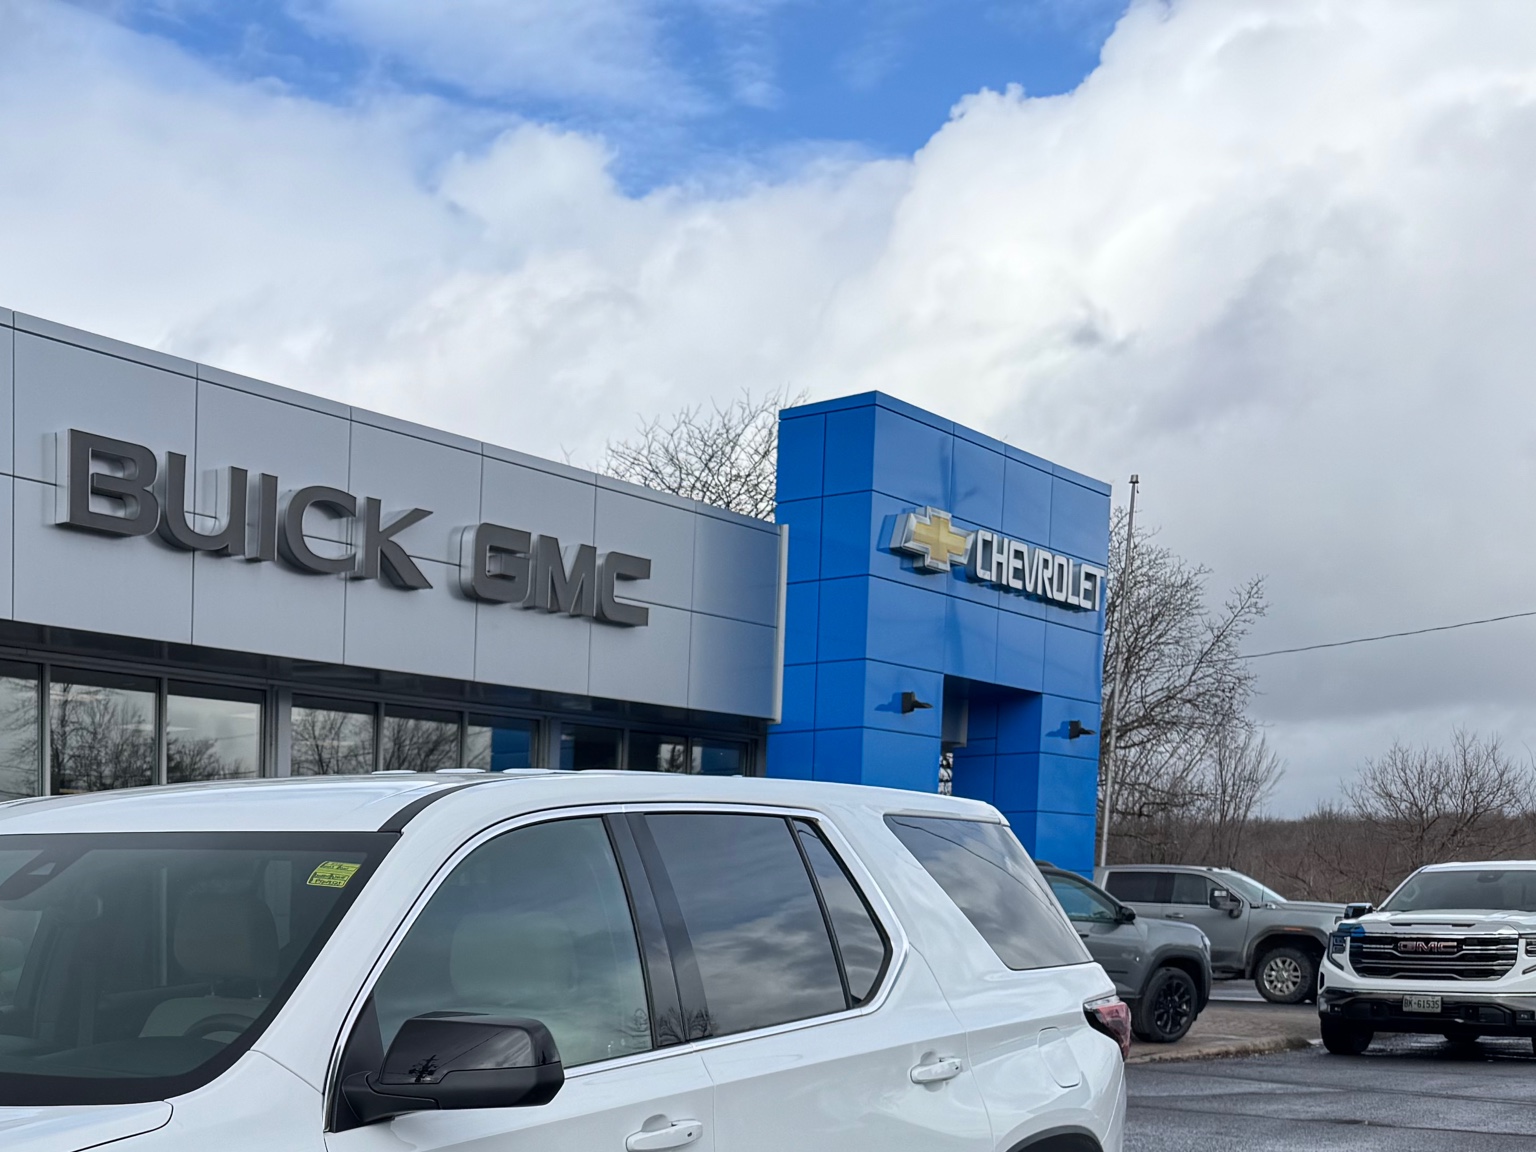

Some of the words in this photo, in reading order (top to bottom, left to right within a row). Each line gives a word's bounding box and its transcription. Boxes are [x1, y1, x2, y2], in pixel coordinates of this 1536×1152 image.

[60, 428, 434, 589] BUICK
[464, 522, 652, 626] GMC
[974, 528, 1106, 612] CHEVROLET
[1398, 941, 1457, 953] GMC
